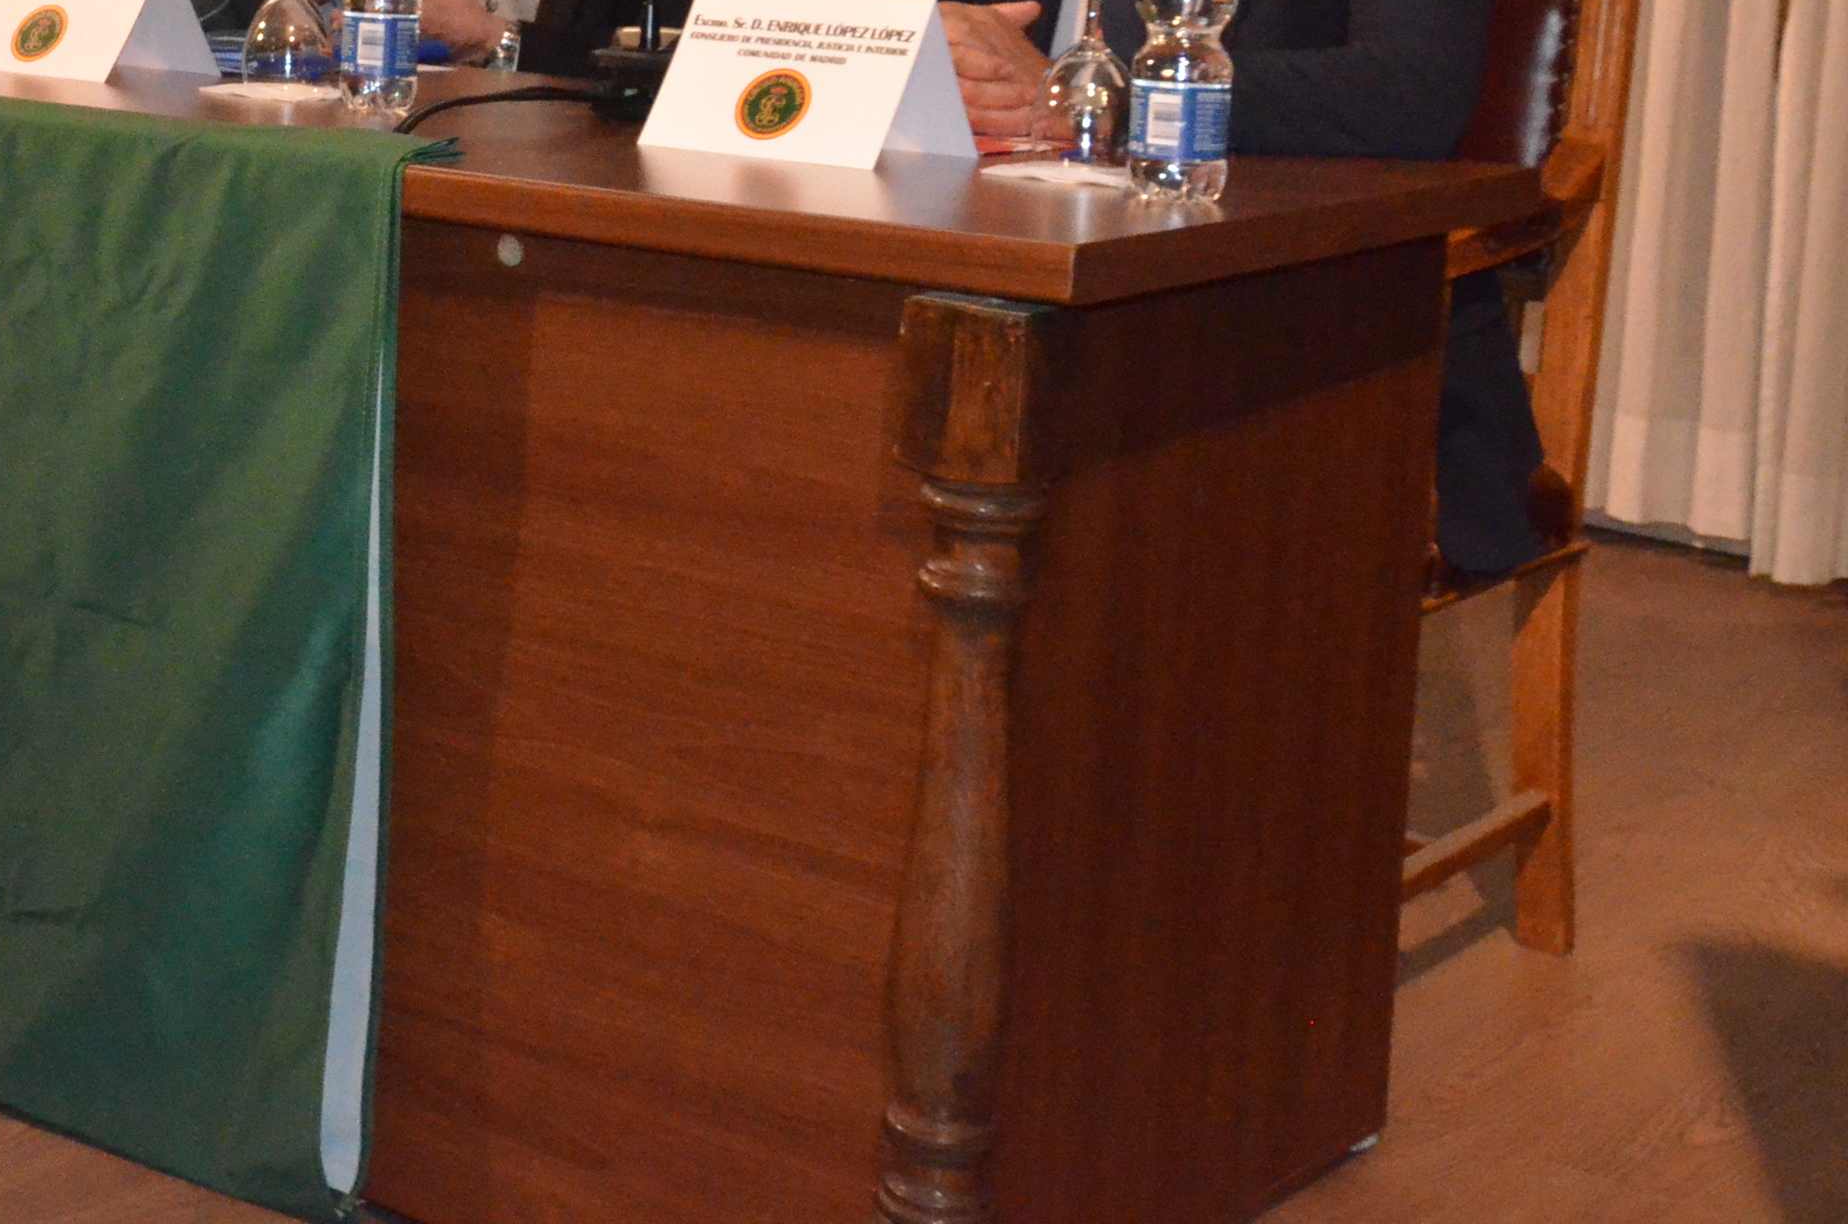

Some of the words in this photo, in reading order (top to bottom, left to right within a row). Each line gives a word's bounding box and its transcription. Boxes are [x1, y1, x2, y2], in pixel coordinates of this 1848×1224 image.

[732, 16, 748, 29] Sr.
[750, 18, 764, 30] D.
[766, 19, 824, 36] ENRIQUE
[825, 22, 871, 40] LÓPEZ
[870, 25, 917, 43] LÓPEZ
[690, 31, 739, 43] CONSEJERO
[740, 34, 753, 43] DE
[815, 40, 855, 52] JUSTICIA
[864, 45, 910, 57] INTERIOR
[737, 48, 792, 60] COMUNIDAD
[793, 52, 806, 61] DE
[808, 54, 848, 66] MADRID
